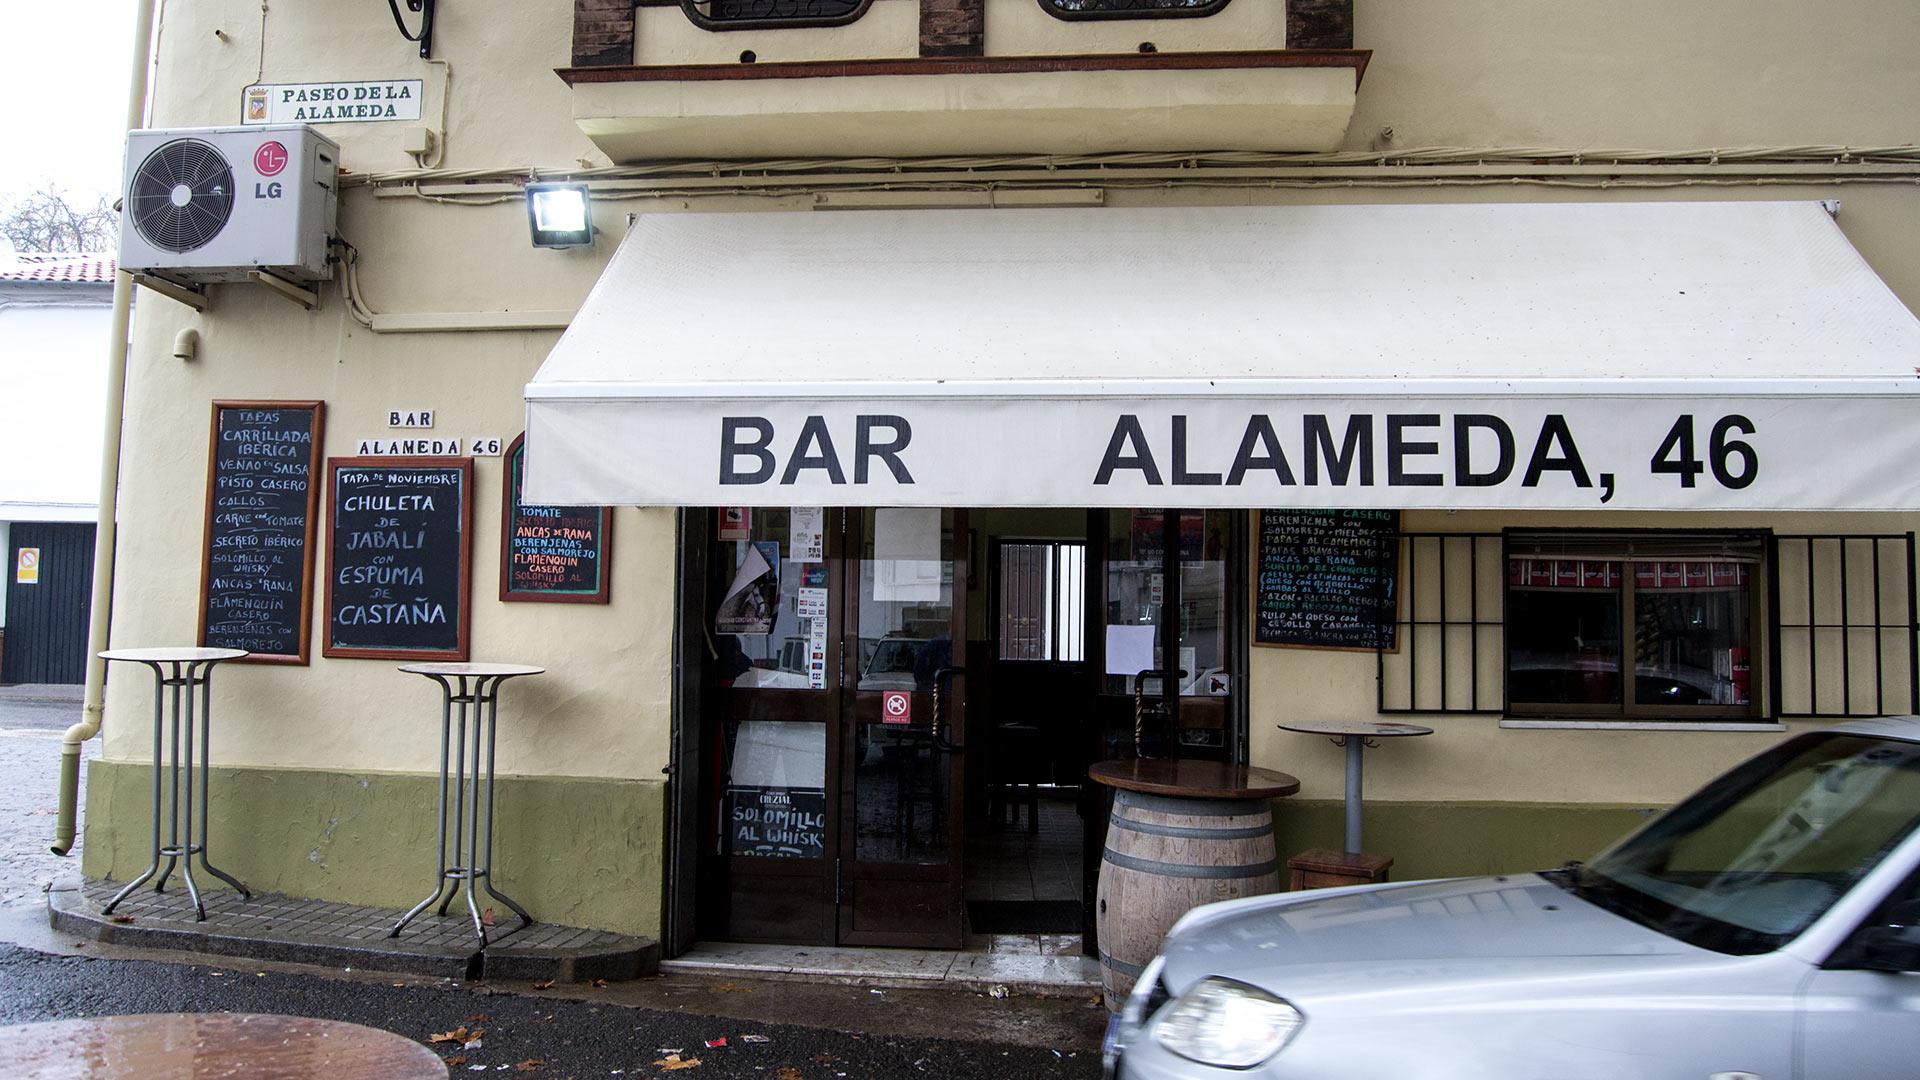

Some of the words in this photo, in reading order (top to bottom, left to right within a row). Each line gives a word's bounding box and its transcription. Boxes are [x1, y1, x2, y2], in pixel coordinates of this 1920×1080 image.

[283, 87, 349, 103] PASEO
[353, 86, 381, 100] DE
[385, 85, 412, 99] LA
[294, 104, 397, 120] ALAMEDA
[255, 182, 282, 199] LG
[240, 411, 280, 422] TAPAS
[389, 412, 430, 426] BAR
[223, 426, 311, 444] CARRILLADA
[359, 440, 458, 454] ALAMEDA
[472, 440, 499, 454] 46
[718, 414, 915, 486] BAR
[1092, 414, 1615, 503] ALAMEDA,
[1650, 414, 1759, 489] 46
[273, 462, 309, 475] SALSA
[219, 476, 254, 488] PISTO
[261, 479, 306, 491] CASERO
[342, 473, 370, 484] TAPA
[388, 472, 457, 485] NOVIEMBRE
[218, 497, 265, 506] CALLOS
[344, 495, 435, 512] CHULETA
[521, 507, 561, 518] TOMATE
[1343, 509, 1391, 521] CASERO
[216, 513, 252, 527] CARNE
[266, 516, 304, 527] TOMATE
[374, 517, 401, 528] DE
[1265, 515, 1336, 526] BERENJENAS
[516, 526, 550, 539] ANCAS
[563, 528, 592, 540] RANA
[1264, 526, 1325, 535] SALMOREJO
[213, 535, 259, 548] SECRETO
[513, 538, 582, 549] BERENJENAS
[1266, 535, 1300, 544] PAPAS
[520, 547, 538, 555] CON
[540, 547, 596, 560] SALMOREJO
[1303, 546, 1339, 556] BRAVAS
[212, 553, 266, 563] SOLOMILLO
[272, 555, 284, 564] AL
[372, 555, 394, 565] CON
[514, 554, 578, 567] FLAMENQUIN
[1265, 555, 1300, 563] ANCAS
[1327, 555, 1356, 565] RANA
[233, 564, 272, 576] WHISKY
[340, 566, 424, 585] ESPUMA
[529, 565, 565, 574] CASERO
[515, 571, 565, 583] SOLOMILLO
[212, 578, 253, 589] ANCAS
[369, 588, 393, 599] DE
[1264, 593, 1296, 601] AZON
[228, 610, 270, 621] CASERO
[338, 597, 447, 625] CASTAÑA
[208, 625, 273, 635] BERENJENAS
[732, 807, 825, 830] SOLOMILLO
[737, 826, 760, 841] AL
